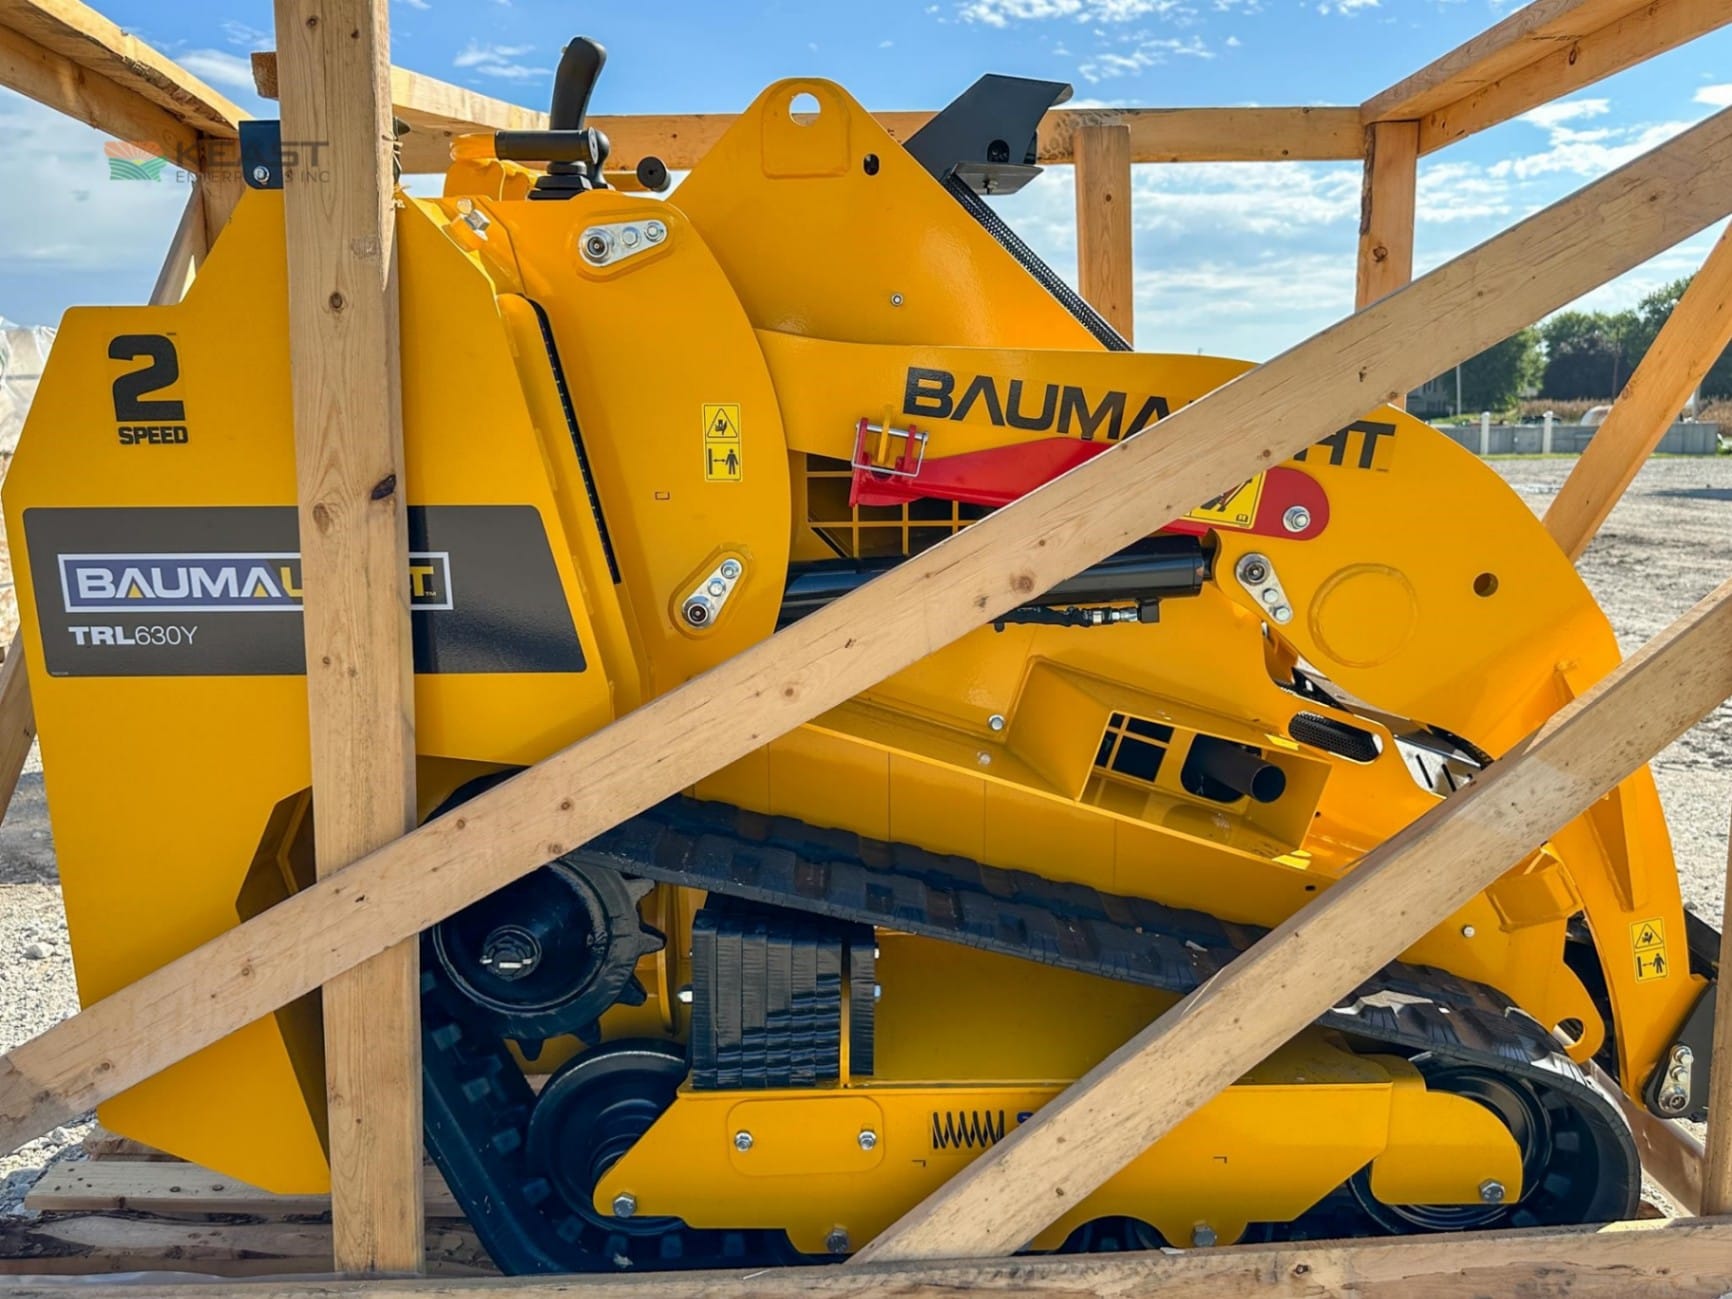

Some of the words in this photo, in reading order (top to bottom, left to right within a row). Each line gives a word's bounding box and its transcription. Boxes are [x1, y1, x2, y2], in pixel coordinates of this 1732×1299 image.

[108, 334, 186, 422] 2
[118, 426, 189, 445] SPEED
[75, 565, 434, 599] BAUMALT
[68, 625, 198, 646] TRL630Y
